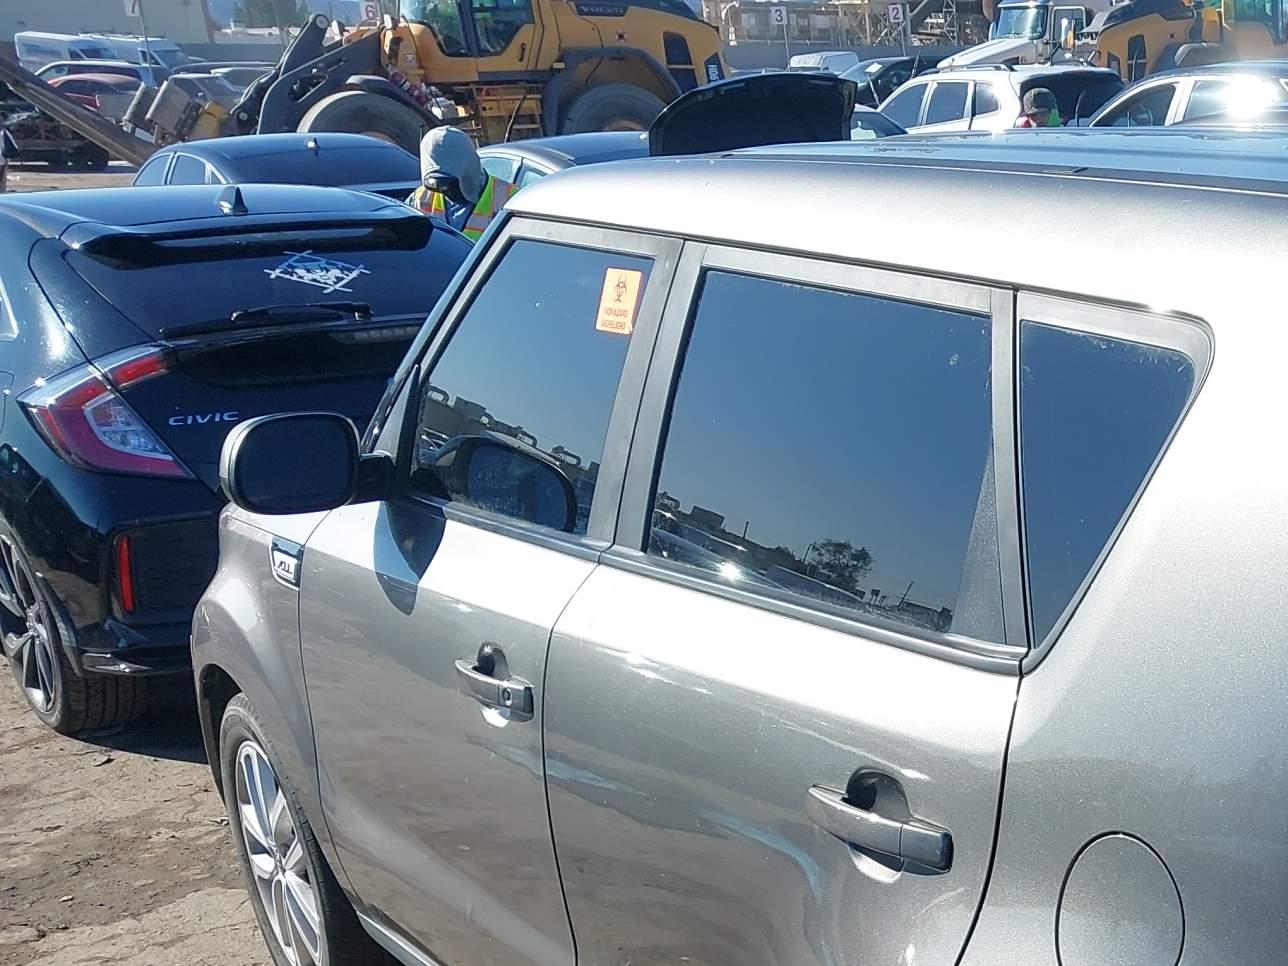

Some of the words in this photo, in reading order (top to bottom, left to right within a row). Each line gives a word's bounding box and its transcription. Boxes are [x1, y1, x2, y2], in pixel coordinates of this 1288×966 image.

[365, 4, 376, 19] 6
[775, 8, 783, 22] 3
[892, 7, 899, 20] 2
[168, 411, 240, 426] CIVIC
